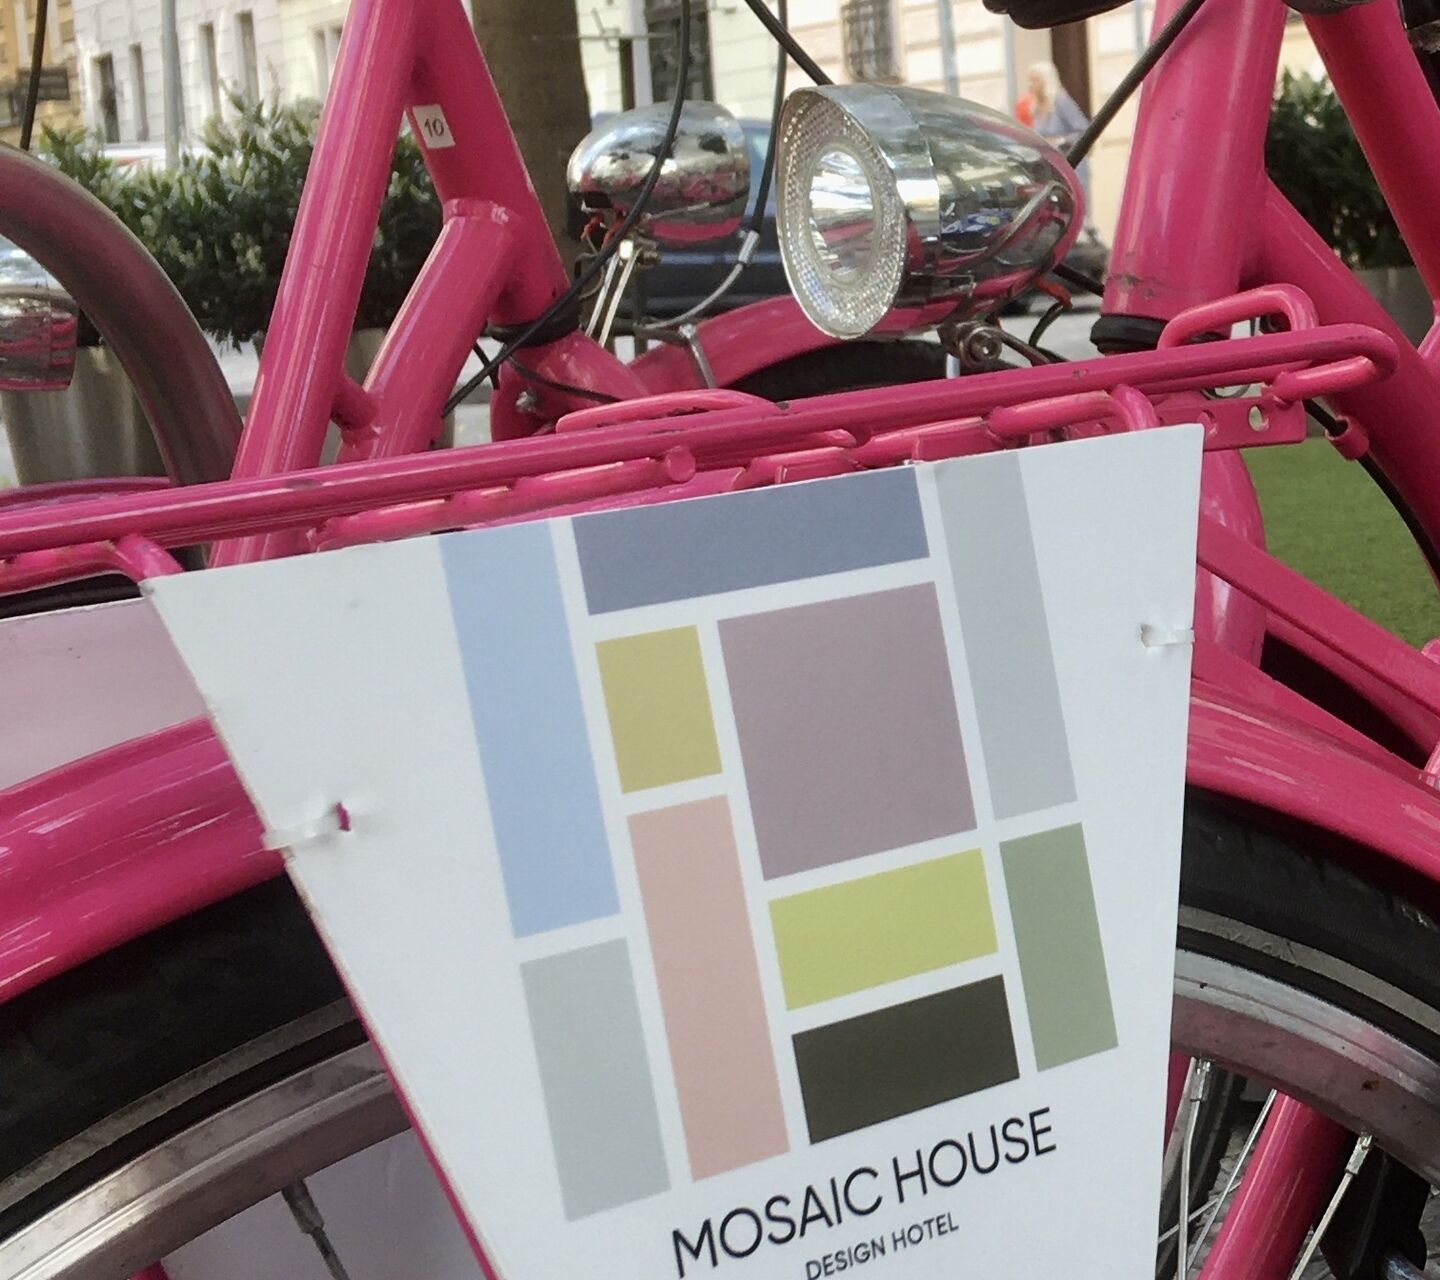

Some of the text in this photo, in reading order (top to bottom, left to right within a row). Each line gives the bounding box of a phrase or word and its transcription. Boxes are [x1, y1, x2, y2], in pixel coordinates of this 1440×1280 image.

[424, 118, 445, 138] 10
[672, 1106, 1057, 1280] MOSAIC HOUSE
[891, 1212, 960, 1252] HOTEL
